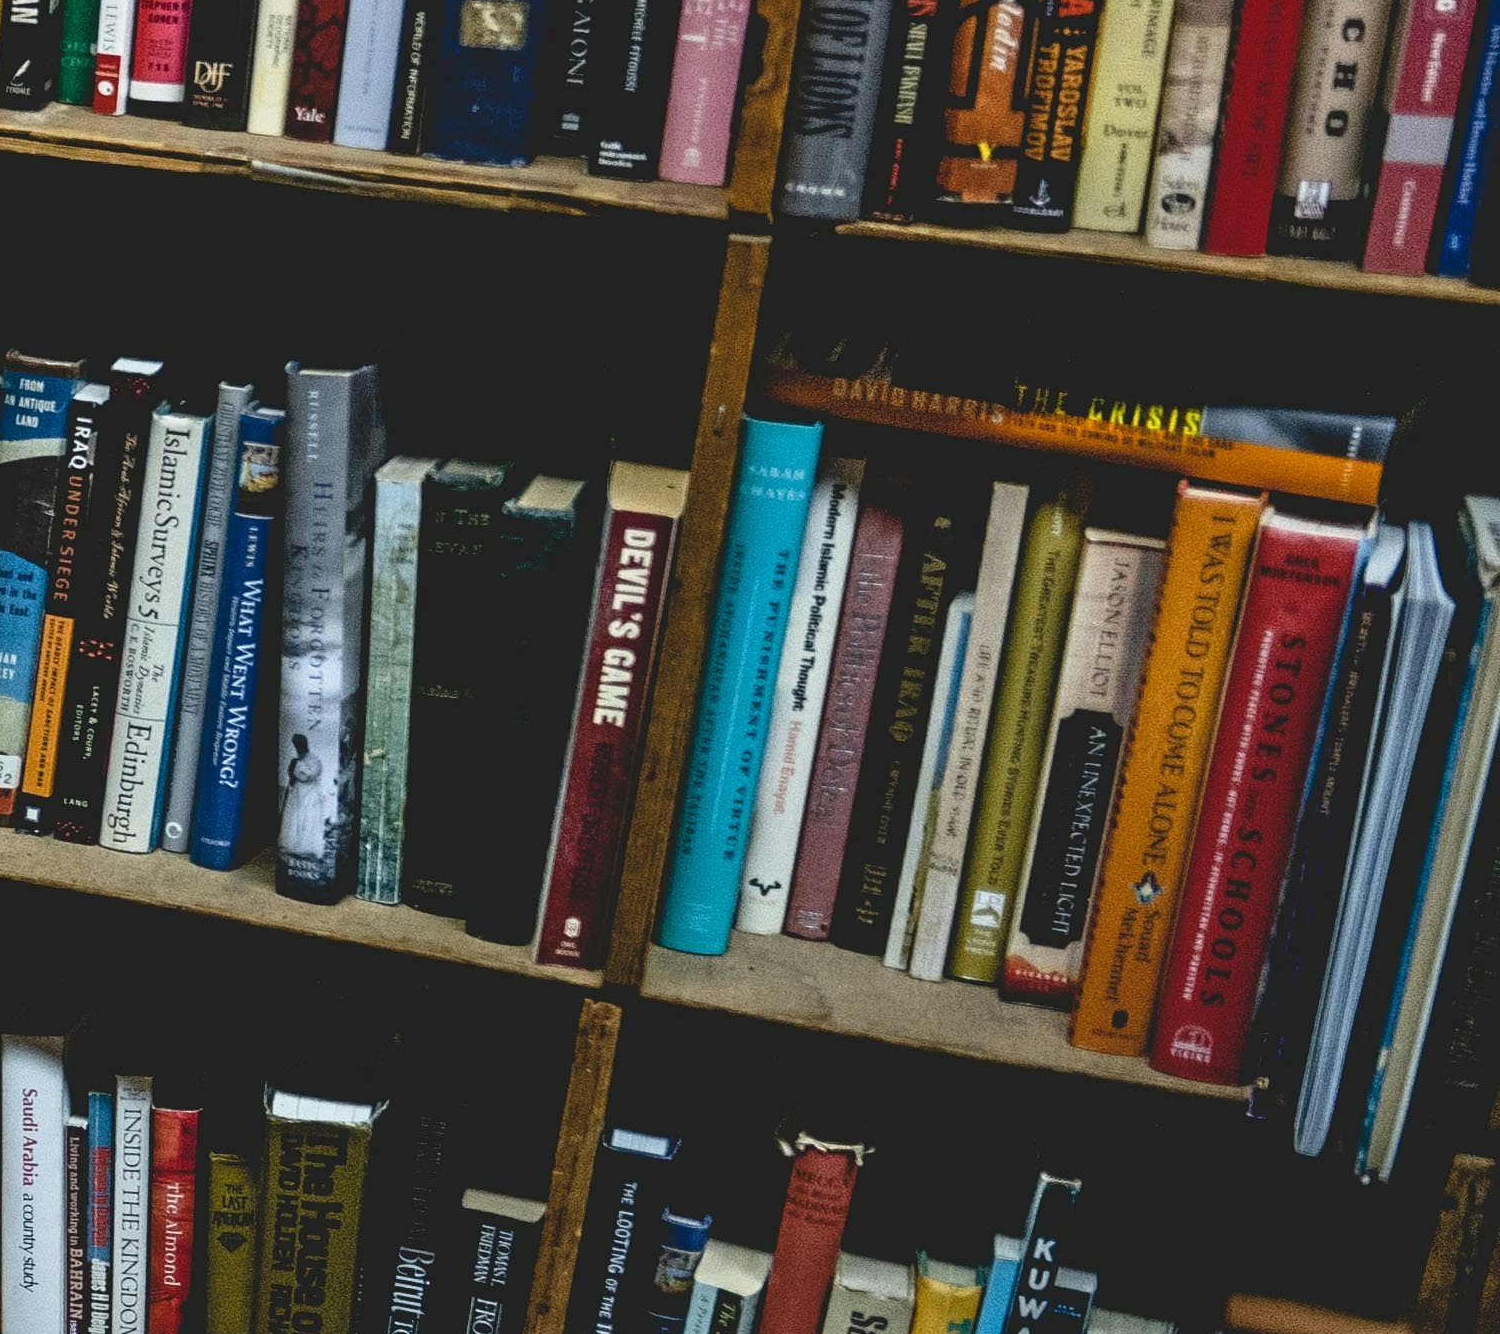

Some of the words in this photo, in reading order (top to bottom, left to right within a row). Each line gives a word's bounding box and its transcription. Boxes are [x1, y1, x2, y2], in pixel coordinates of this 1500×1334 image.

[608, 528, 656, 640] DEVIL'S
[593, 647, 642, 728] GAME
[109, 723, 151, 843] Edinburgh
